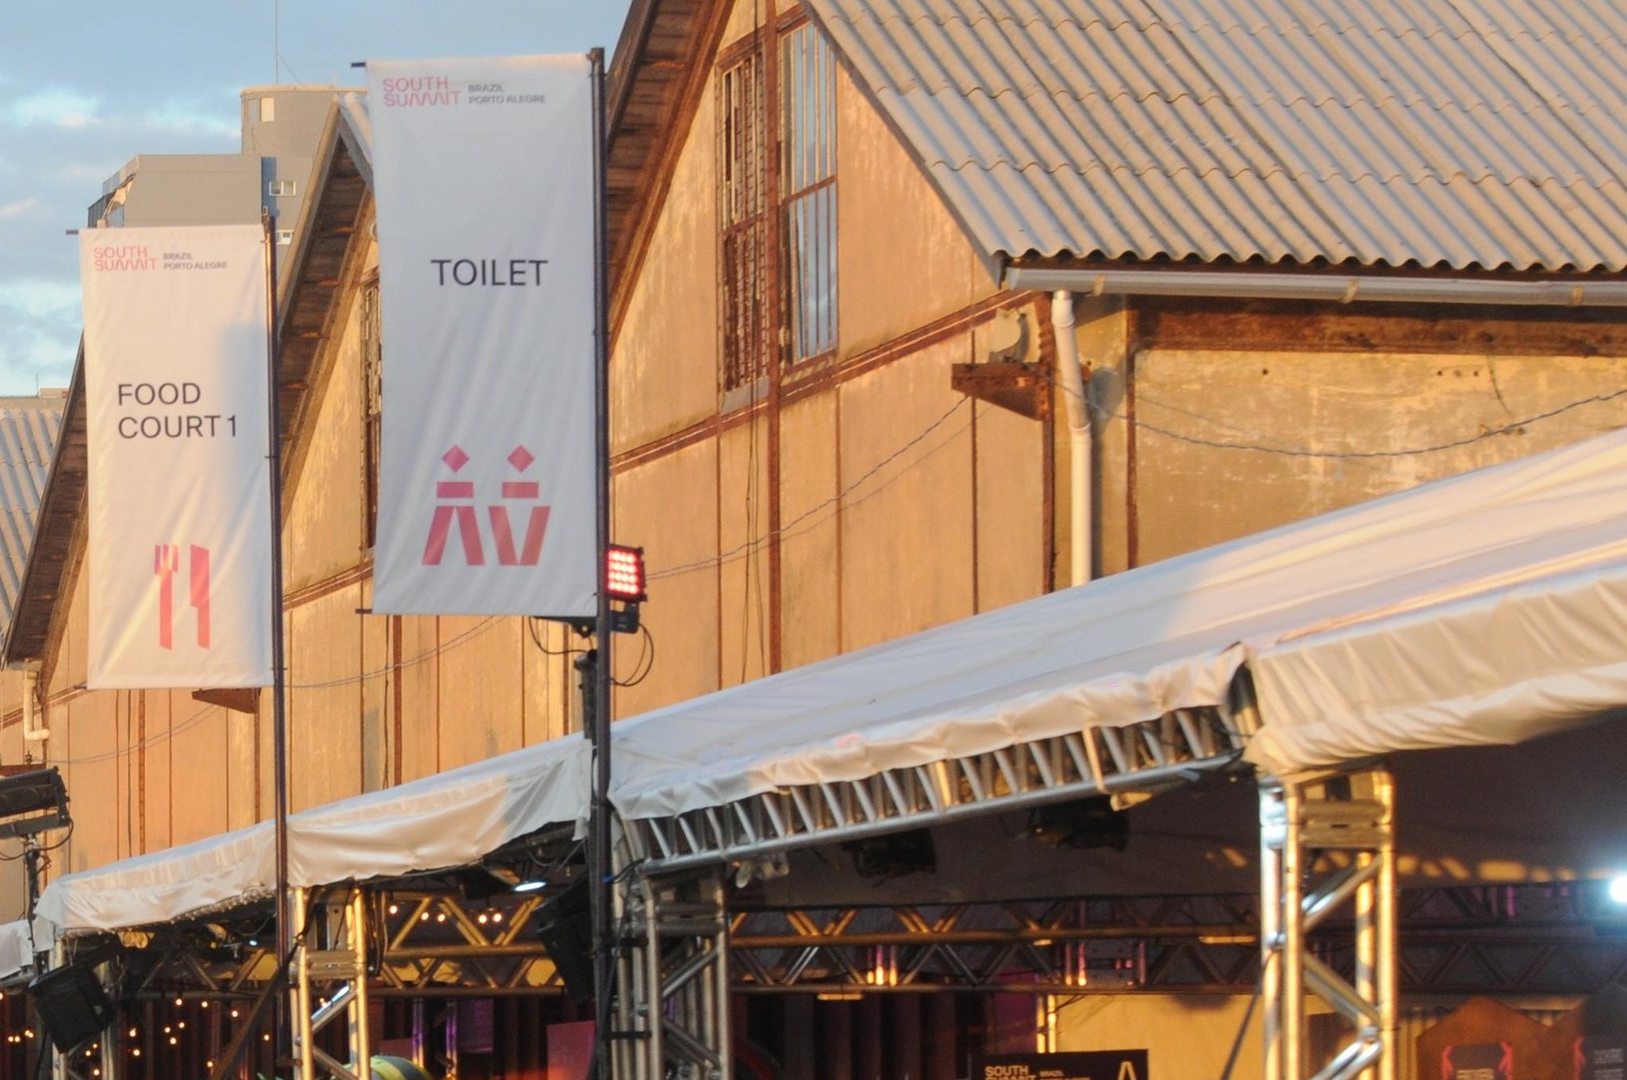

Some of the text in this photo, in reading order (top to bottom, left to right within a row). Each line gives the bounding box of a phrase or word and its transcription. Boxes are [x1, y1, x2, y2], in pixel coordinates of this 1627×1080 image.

[382, 76, 449, 93] SOUTH
[468, 84, 504, 93] BRAZIL
[469, 94, 547, 104] PORTO ALEGRE
[93, 246, 148, 260] SOUTH
[163, 261, 227, 270] PORTO ALEGRE
[431, 258, 549, 287] TOILET
[117, 382, 202, 406] FOOD
[117, 414, 238, 439] COURT 1
[984, 1065, 1029, 1077] SOUTH
